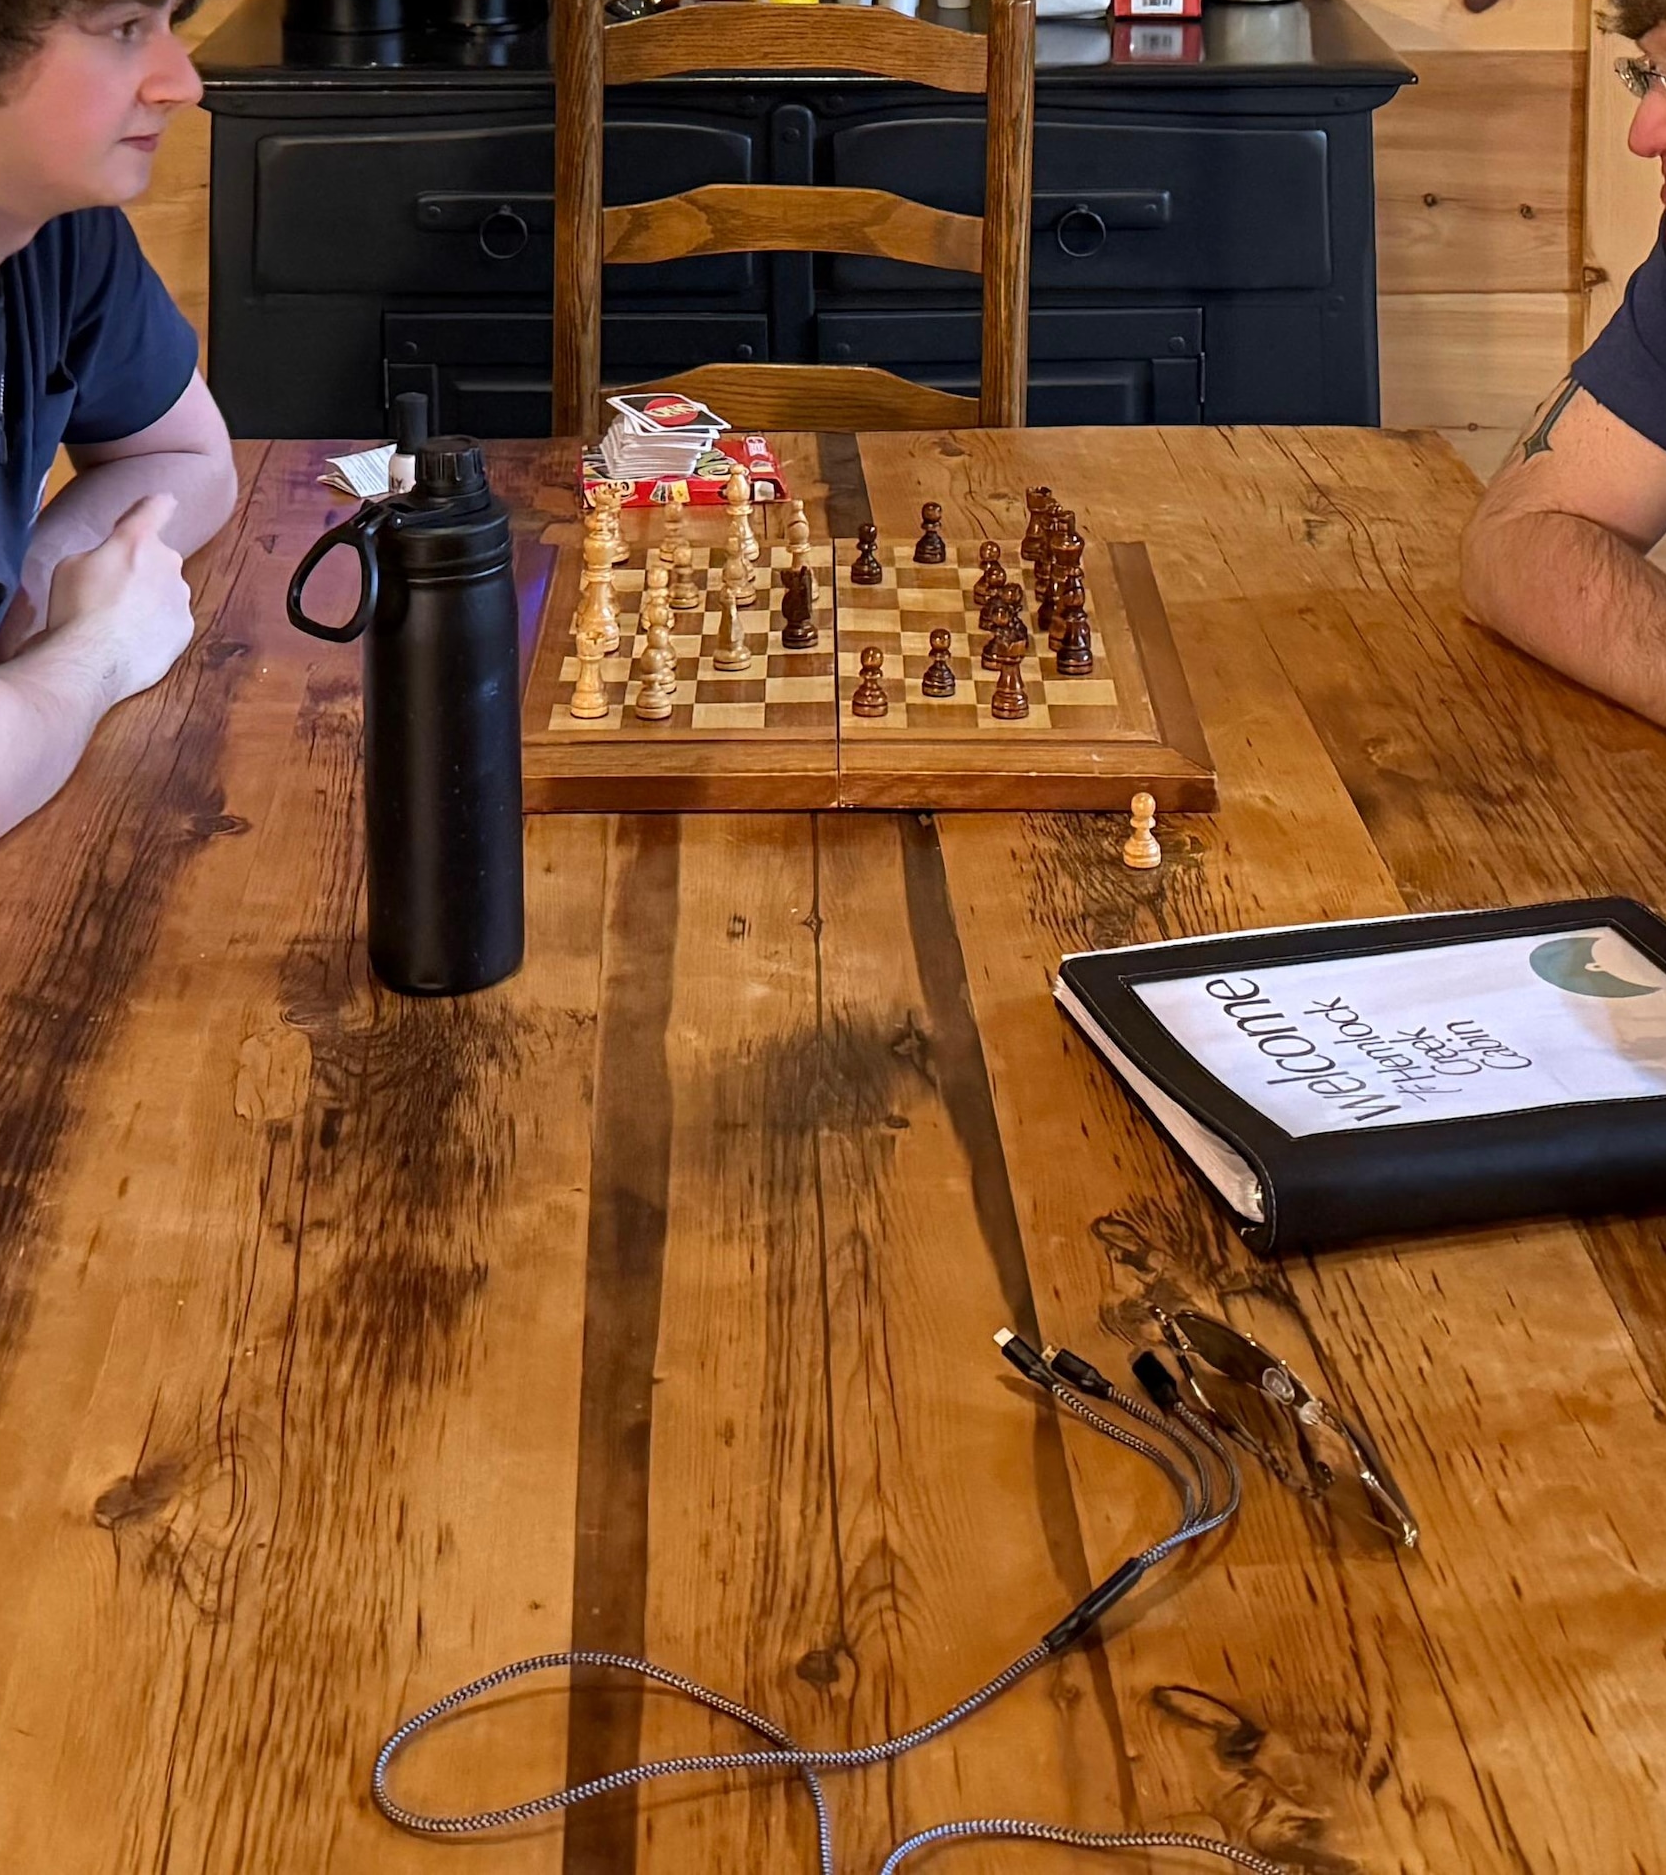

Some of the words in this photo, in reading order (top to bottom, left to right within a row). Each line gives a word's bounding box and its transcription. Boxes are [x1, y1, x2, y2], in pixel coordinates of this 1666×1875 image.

[1303, 996, 1436, 1083] Hemlock
[1388, 1026, 1482, 1075] Creek
[1446, 1020, 1533, 1070] Cabin
